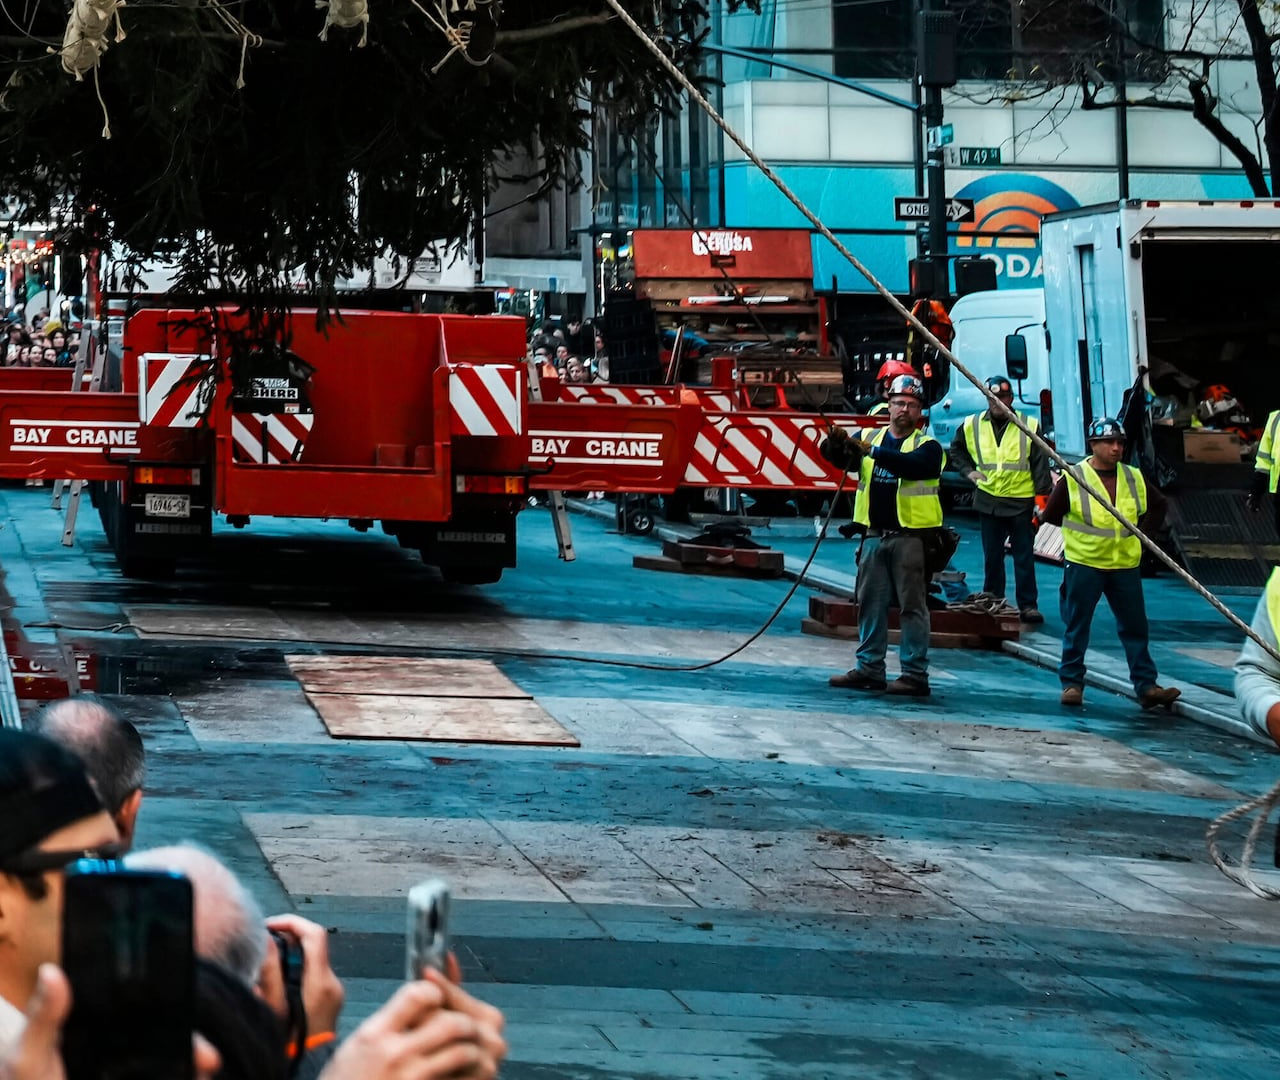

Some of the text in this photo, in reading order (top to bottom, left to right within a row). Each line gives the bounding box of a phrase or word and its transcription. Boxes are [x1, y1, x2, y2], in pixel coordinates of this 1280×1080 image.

[960, 149, 970, 164] W
[973, 149, 988, 164] 49
[13, 428, 138, 445] BAY CRANE
[531, 438, 660, 457] BAY CRANE
